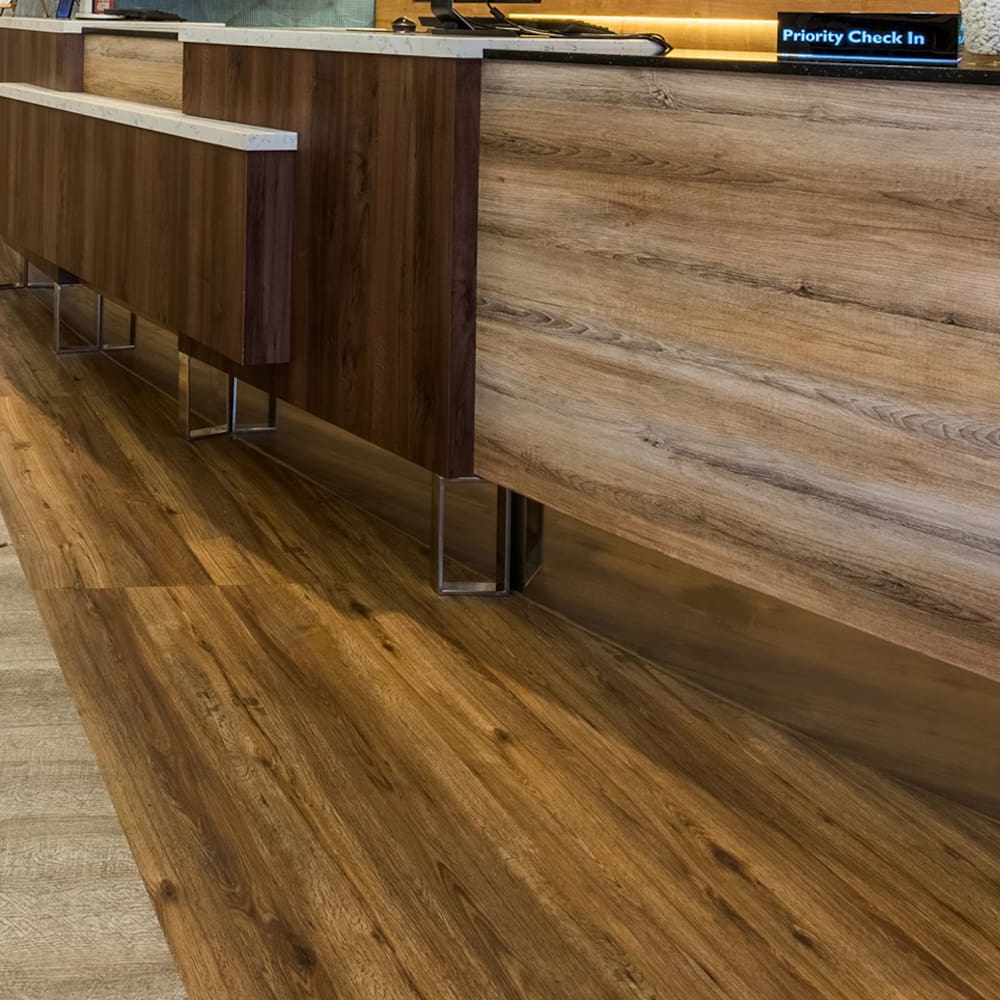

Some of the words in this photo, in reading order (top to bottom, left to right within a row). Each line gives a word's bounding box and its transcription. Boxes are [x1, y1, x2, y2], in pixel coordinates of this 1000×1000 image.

[782, 29, 844, 46] Priority
[848, 30, 903, 44] Check
[908, 31, 925, 45] In
